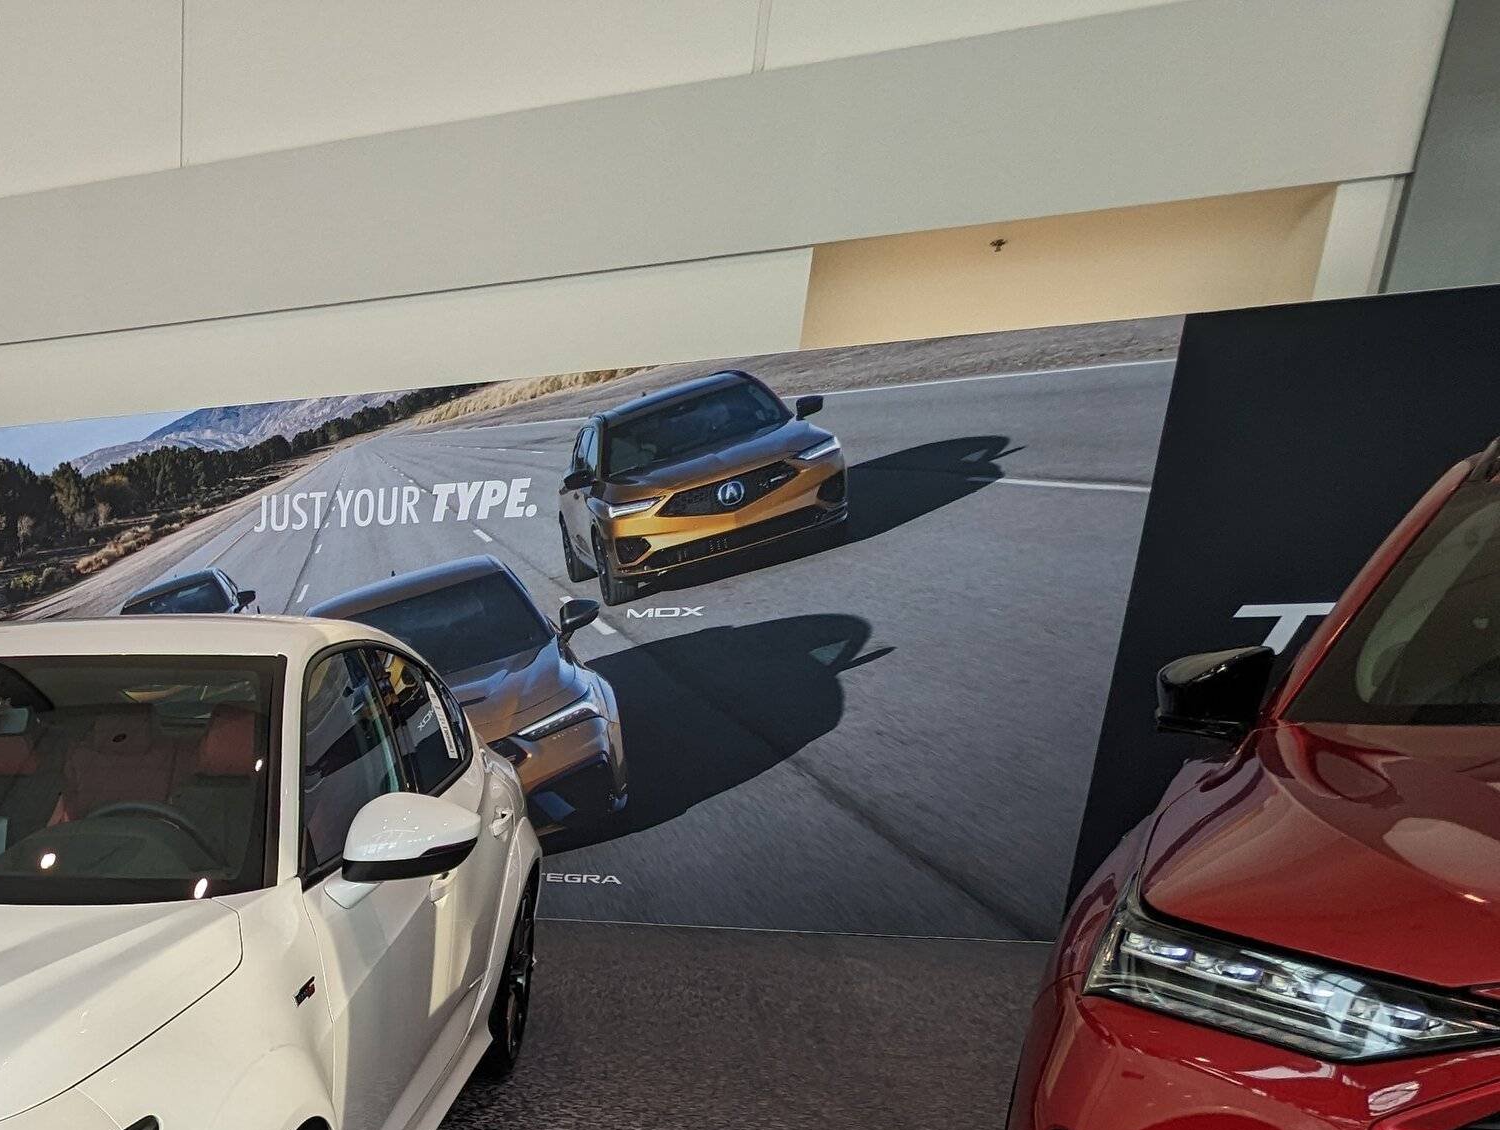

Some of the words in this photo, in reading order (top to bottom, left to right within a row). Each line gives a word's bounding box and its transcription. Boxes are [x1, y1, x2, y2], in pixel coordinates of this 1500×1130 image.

[254, 491, 327, 532] JUST
[336, 486, 420, 528] YOUR
[432, 478, 537, 522] TYPE.
[627, 606, 704, 618] MDX
